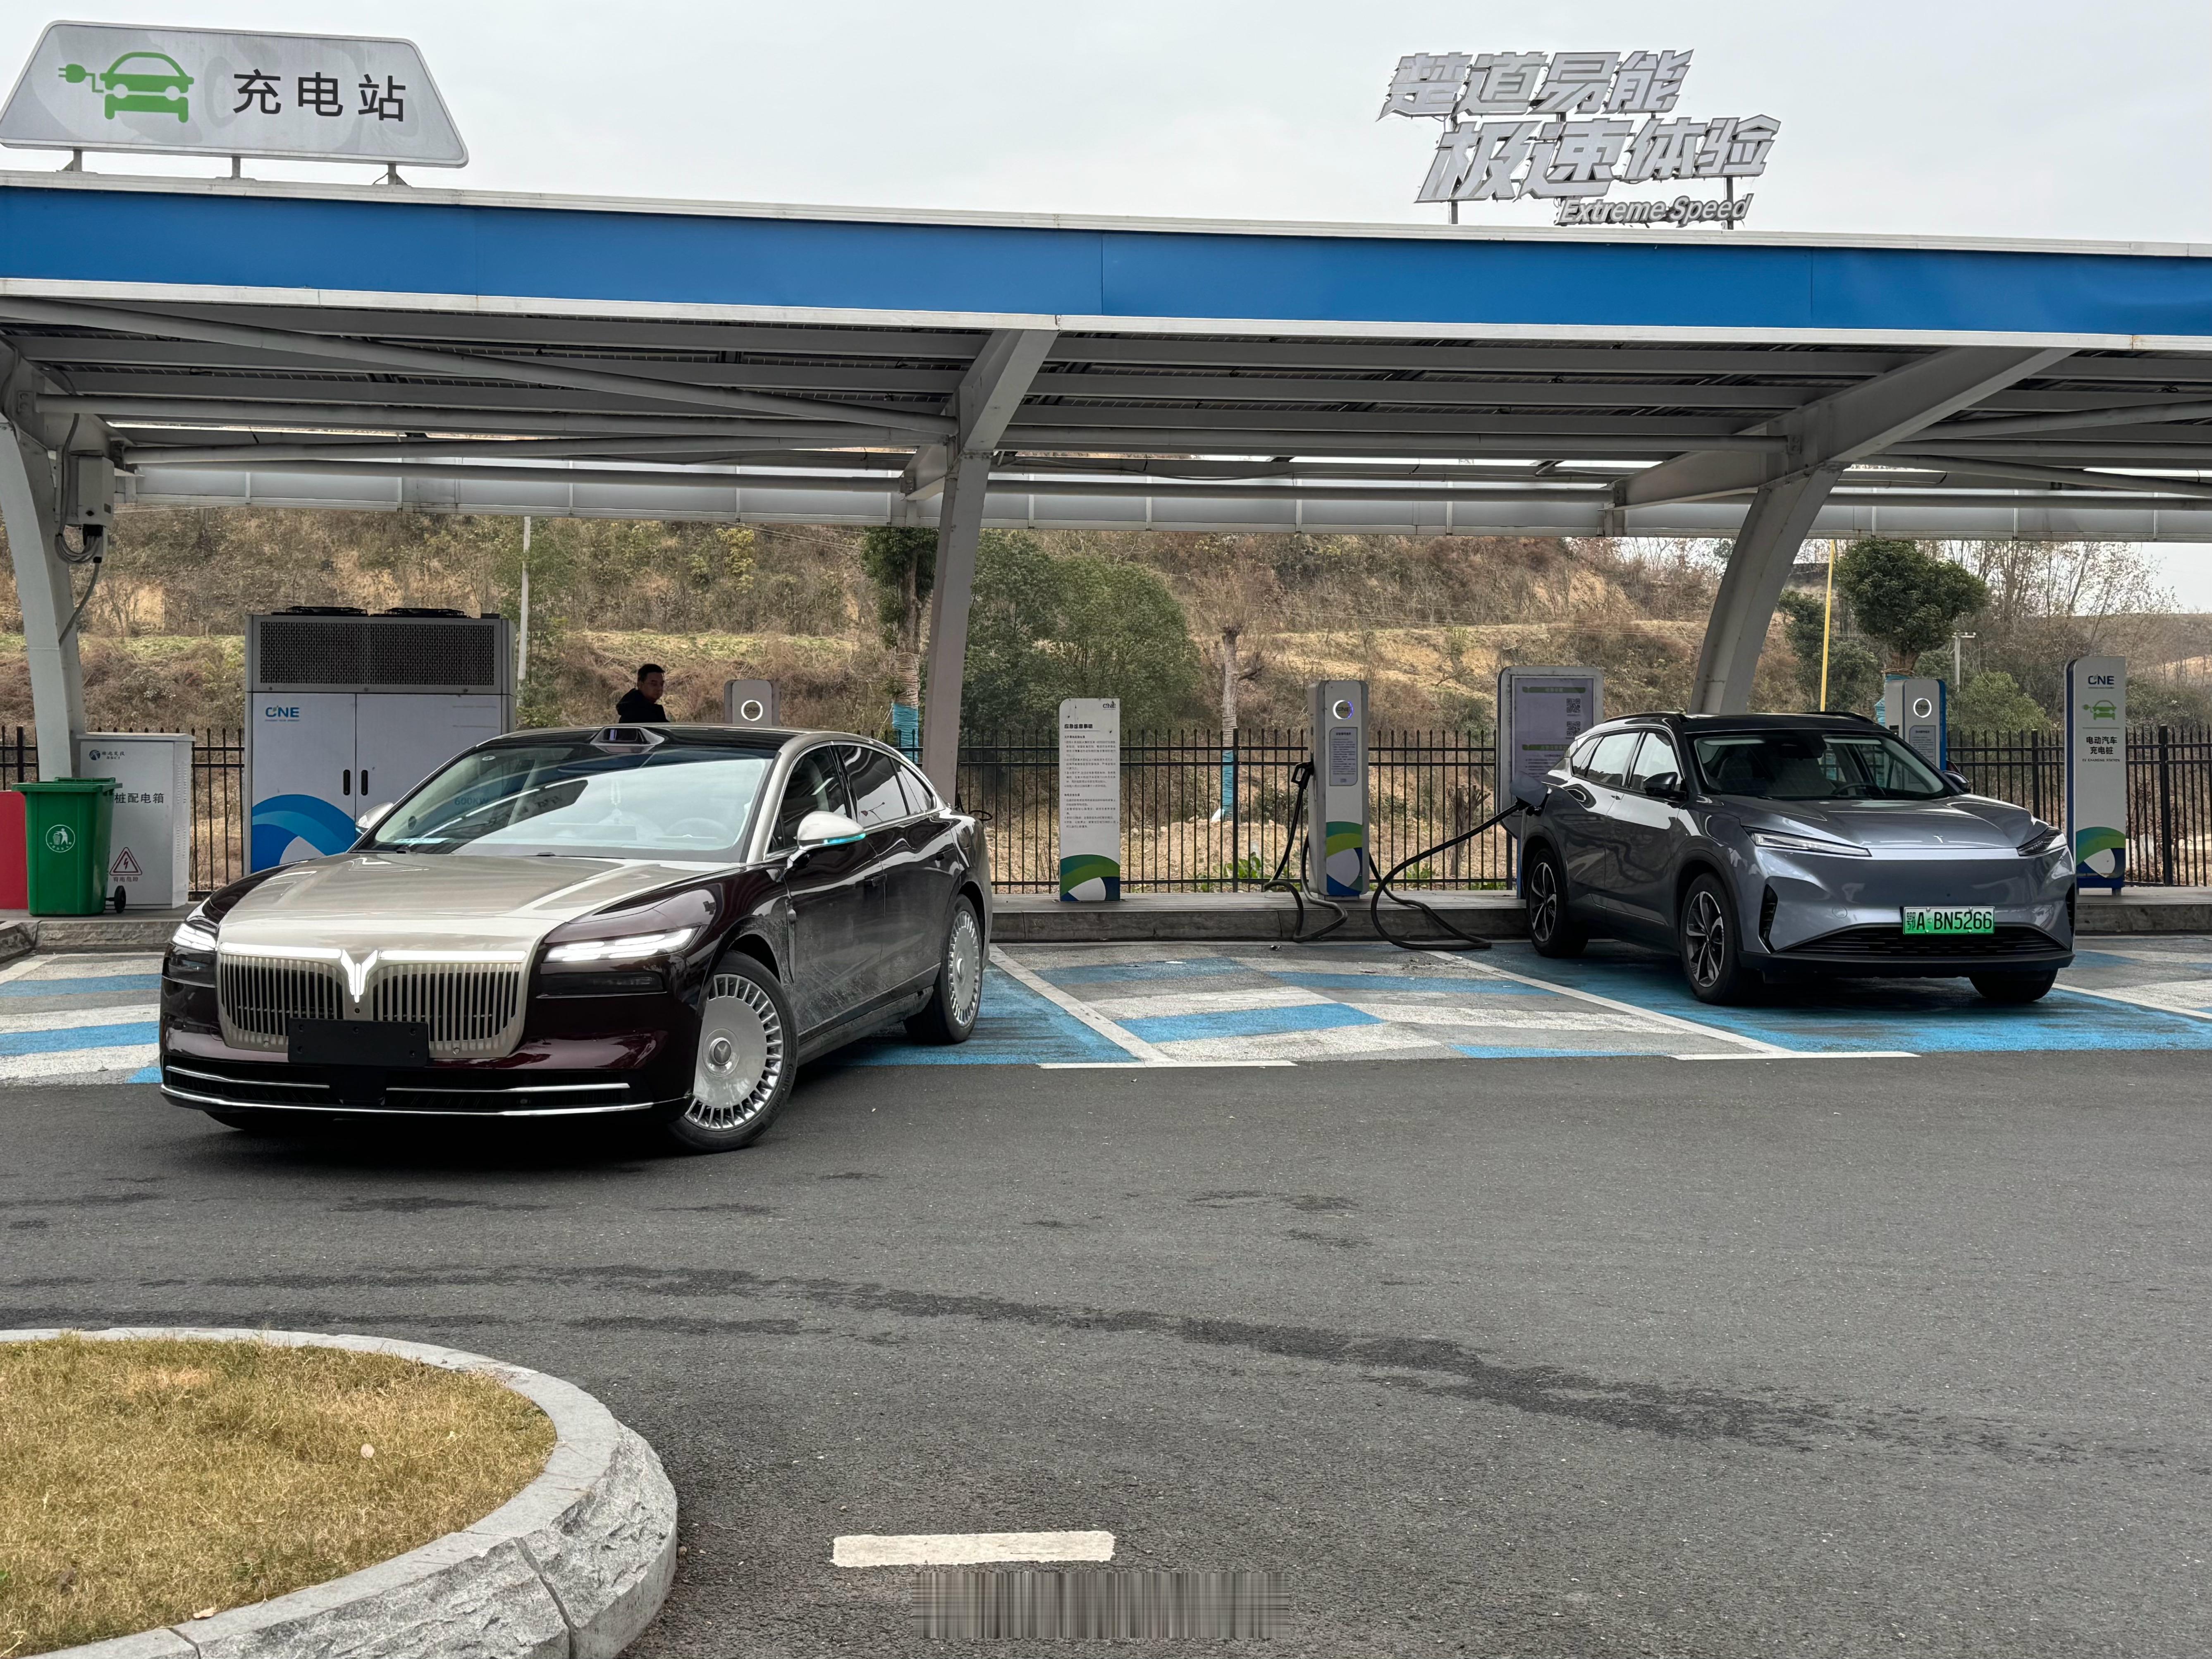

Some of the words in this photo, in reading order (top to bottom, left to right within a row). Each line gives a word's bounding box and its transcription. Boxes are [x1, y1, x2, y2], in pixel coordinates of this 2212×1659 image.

[232, 69, 406, 122] 充电站
[1376, 48, 1694, 122] 楚道易能
[1414, 114, 1781, 203] 极速体验
[1555, 198, 1669, 225] Extreme
[1670, 193, 1754, 227] Speed
[2088, 675, 2114, 685] CNE
[265, 706, 299, 717] CNE
[1934, 911, 1992, 930] BN5266
